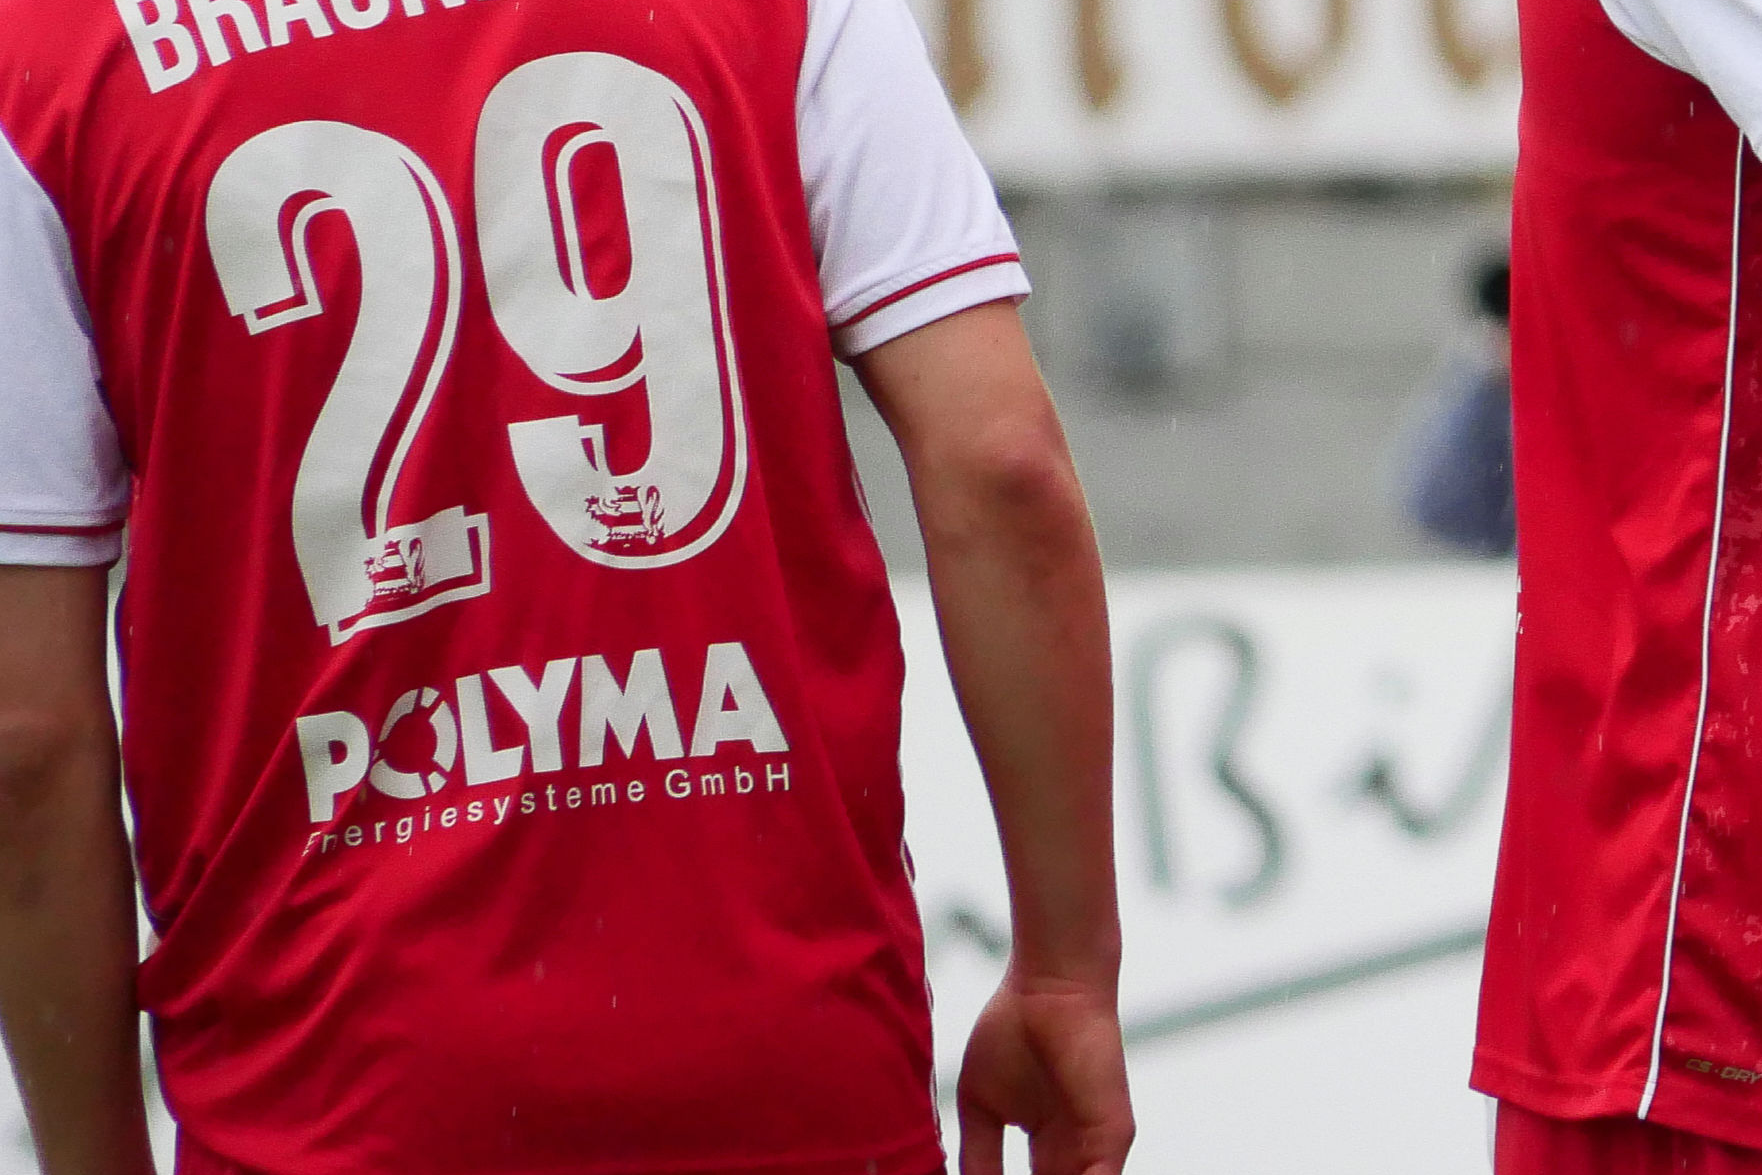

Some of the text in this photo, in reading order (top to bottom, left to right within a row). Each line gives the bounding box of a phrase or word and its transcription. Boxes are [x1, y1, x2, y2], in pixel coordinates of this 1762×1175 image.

[205, 52, 747, 646] 29
[296, 642, 790, 823] POLYMA
[302, 763, 791, 857] Energiesysteme GmbH
